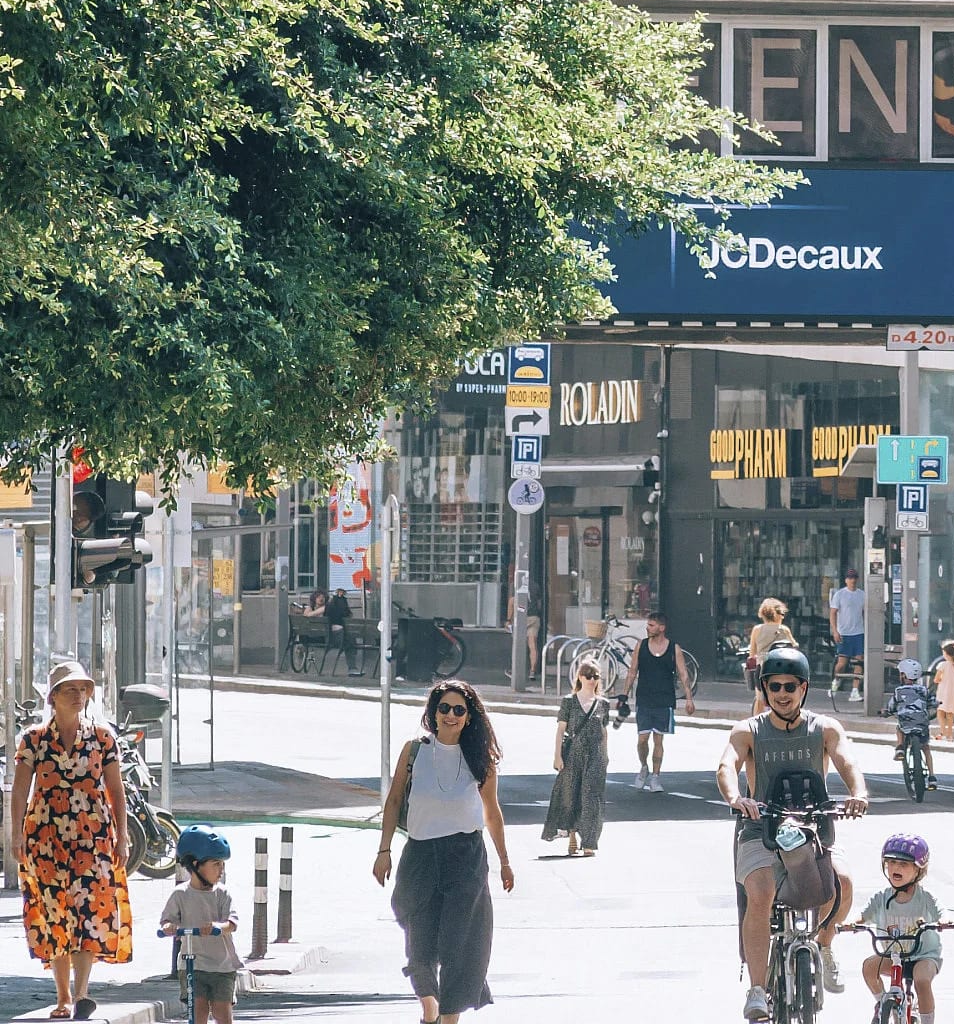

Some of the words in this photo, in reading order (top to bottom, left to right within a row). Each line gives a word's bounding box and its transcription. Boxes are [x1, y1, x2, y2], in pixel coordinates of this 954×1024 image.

[687, 37, 908, 134] EN
[708, 237, 883, 270] JCDecaux
[509, 390, 549, 404] 10:00-19:00
[560, 379, 639, 426] ROLADIN
